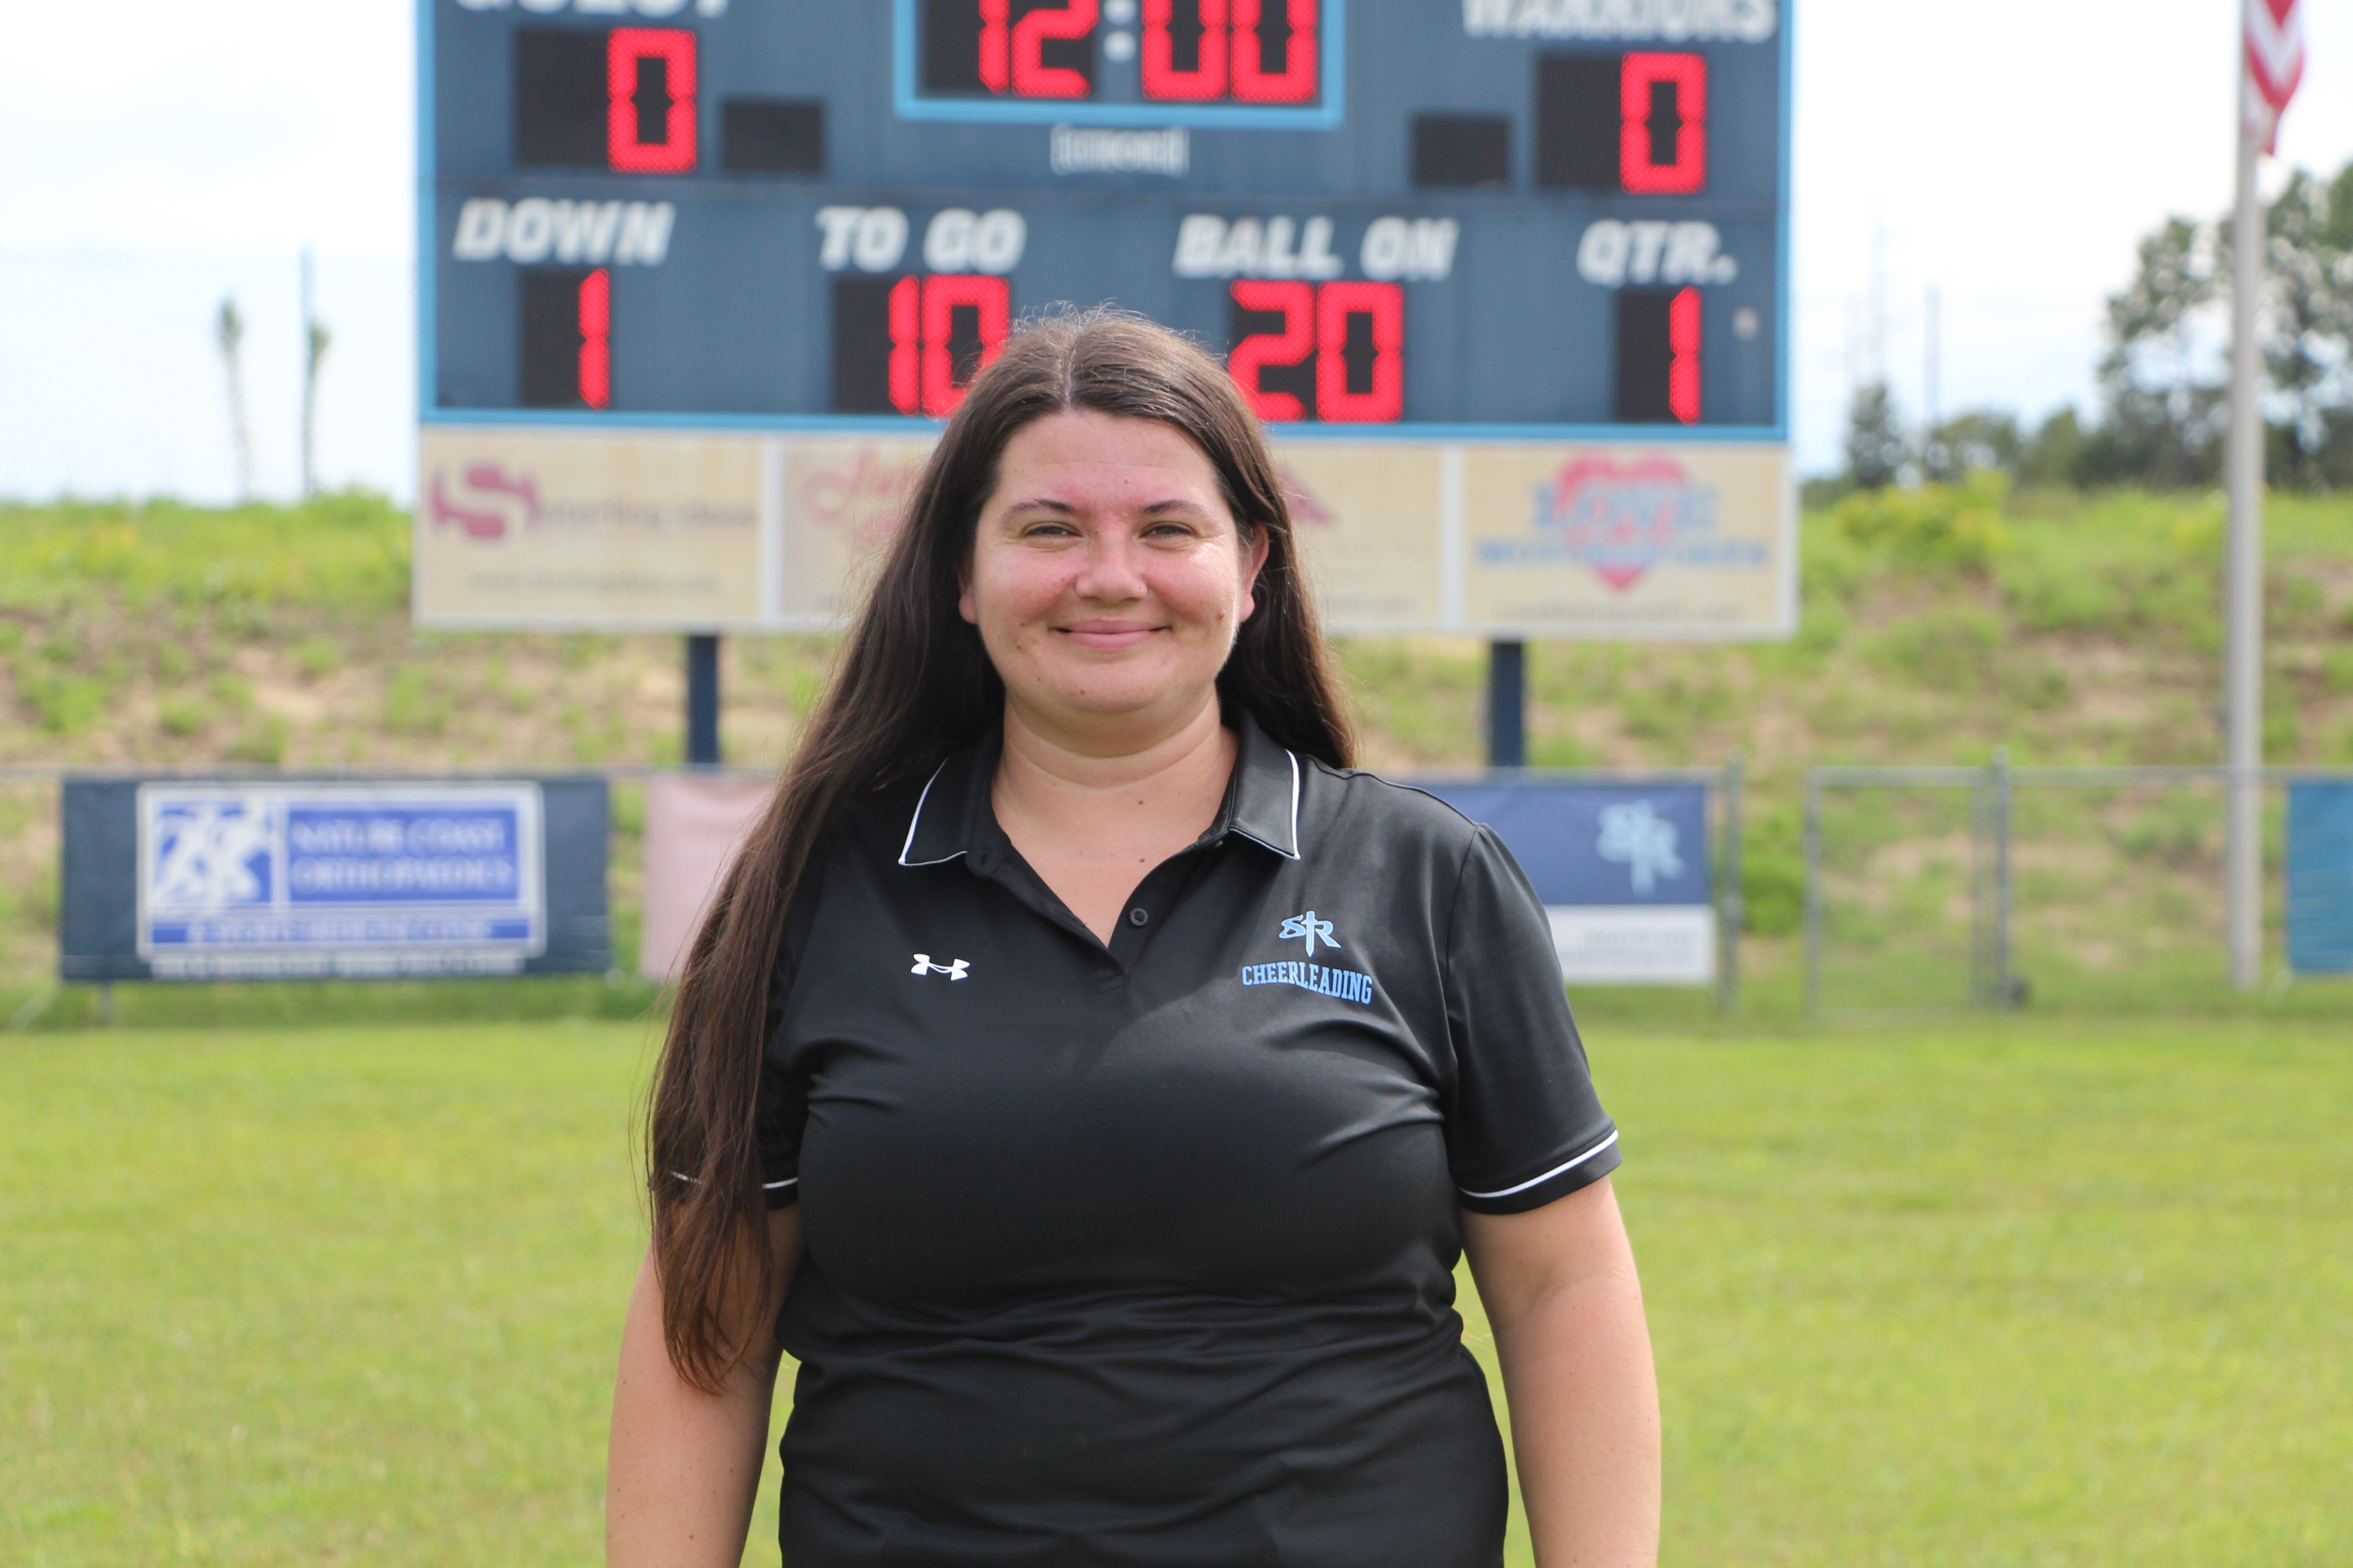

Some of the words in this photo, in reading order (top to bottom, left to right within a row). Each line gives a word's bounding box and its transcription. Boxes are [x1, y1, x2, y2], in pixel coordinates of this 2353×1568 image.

[607, 27, 696, 173] 0
[978, 0, 1318, 103] 12:00
[1621, 52, 1707, 195] 0
[452, 197, 677, 266] DOWN
[814, 206, 909, 273] TO
[922, 207, 1028, 275] GO
[1171, 213, 1345, 278] BALL
[1359, 215, 1460, 281] ON
[1576, 218, 1739, 288] QTR.
[578, 267, 610, 411] 1
[888, 273, 1009, 419] 10
[1228, 279, 1403, 424] 20
[1669, 285, 1702, 426] 1
[1241, 961, 1372, 1005] CHEERLEADING
